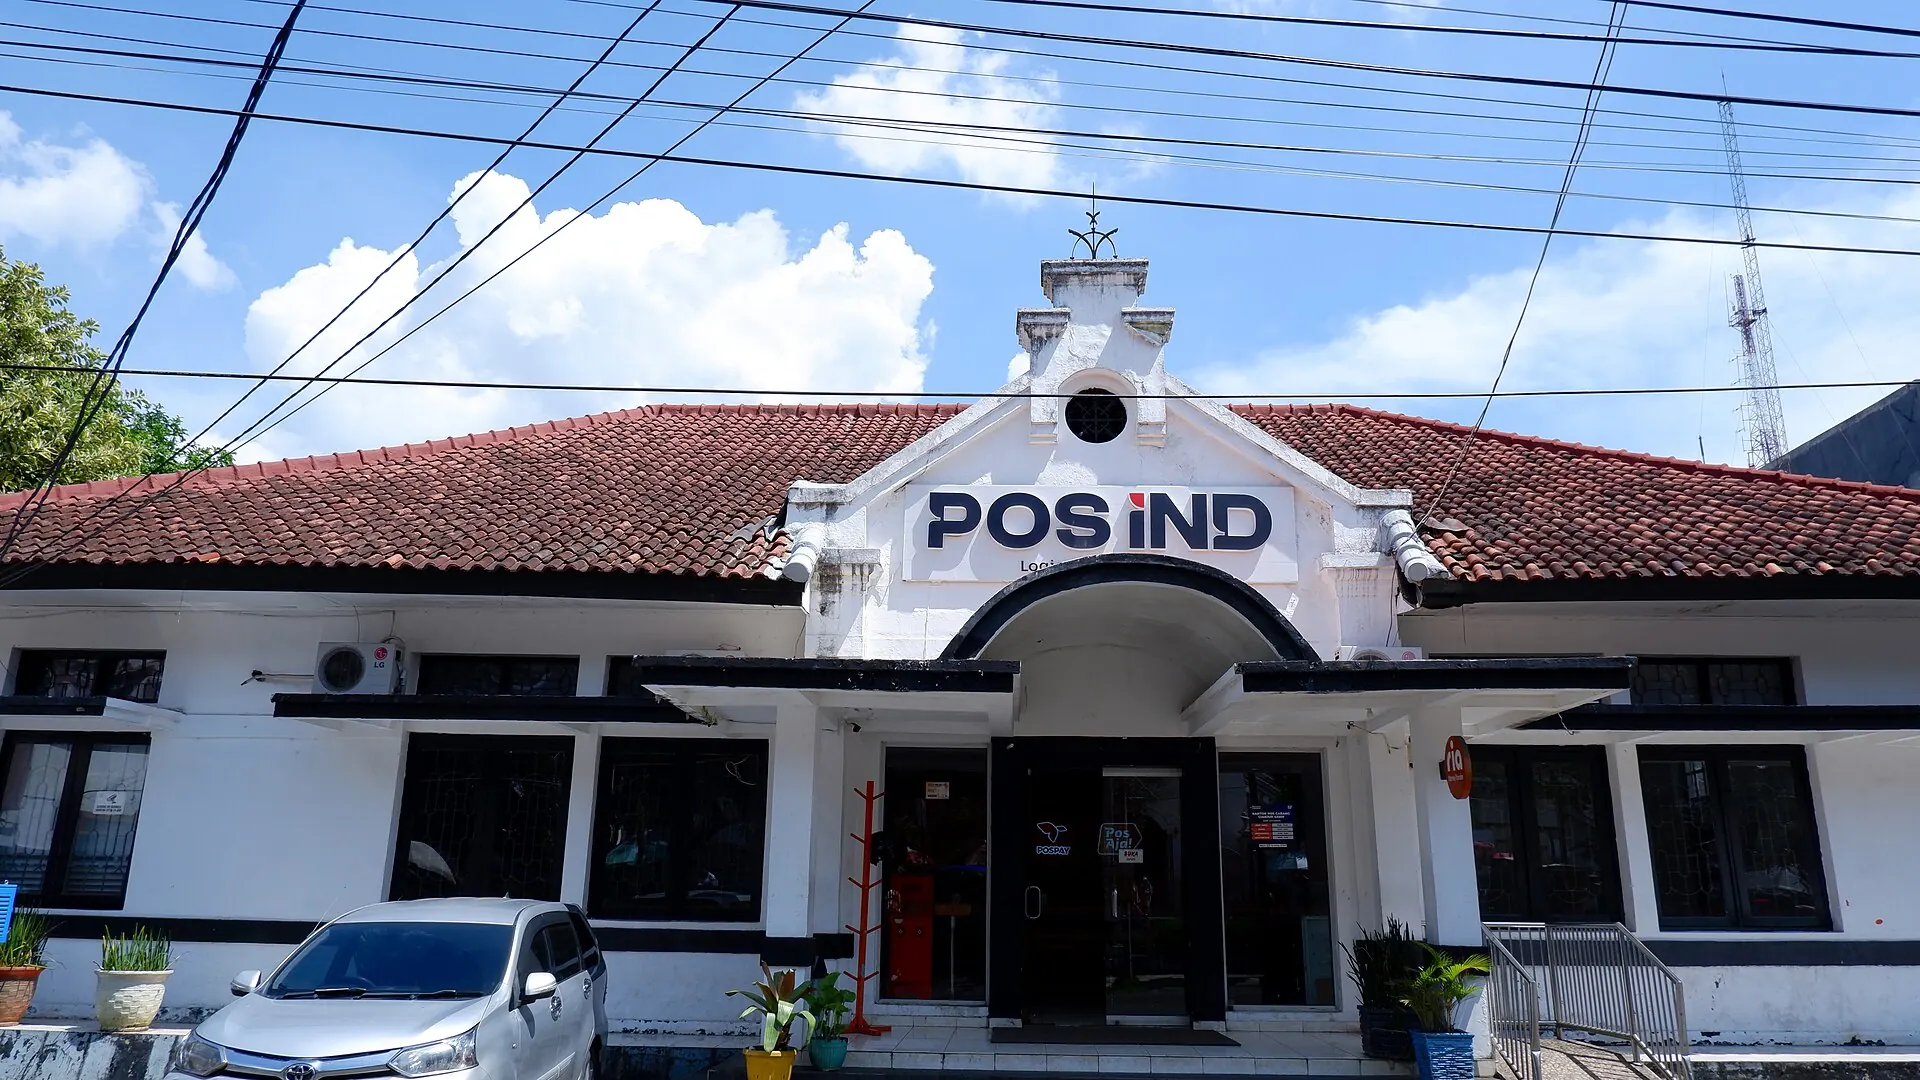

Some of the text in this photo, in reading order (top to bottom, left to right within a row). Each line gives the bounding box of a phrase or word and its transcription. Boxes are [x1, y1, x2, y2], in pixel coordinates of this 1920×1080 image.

[928, 492, 1111, 549] POS
[1446, 740, 1463, 771] ria
[1104, 827, 1130, 838] Pos
[1036, 846, 1070, 855] POSPAY
